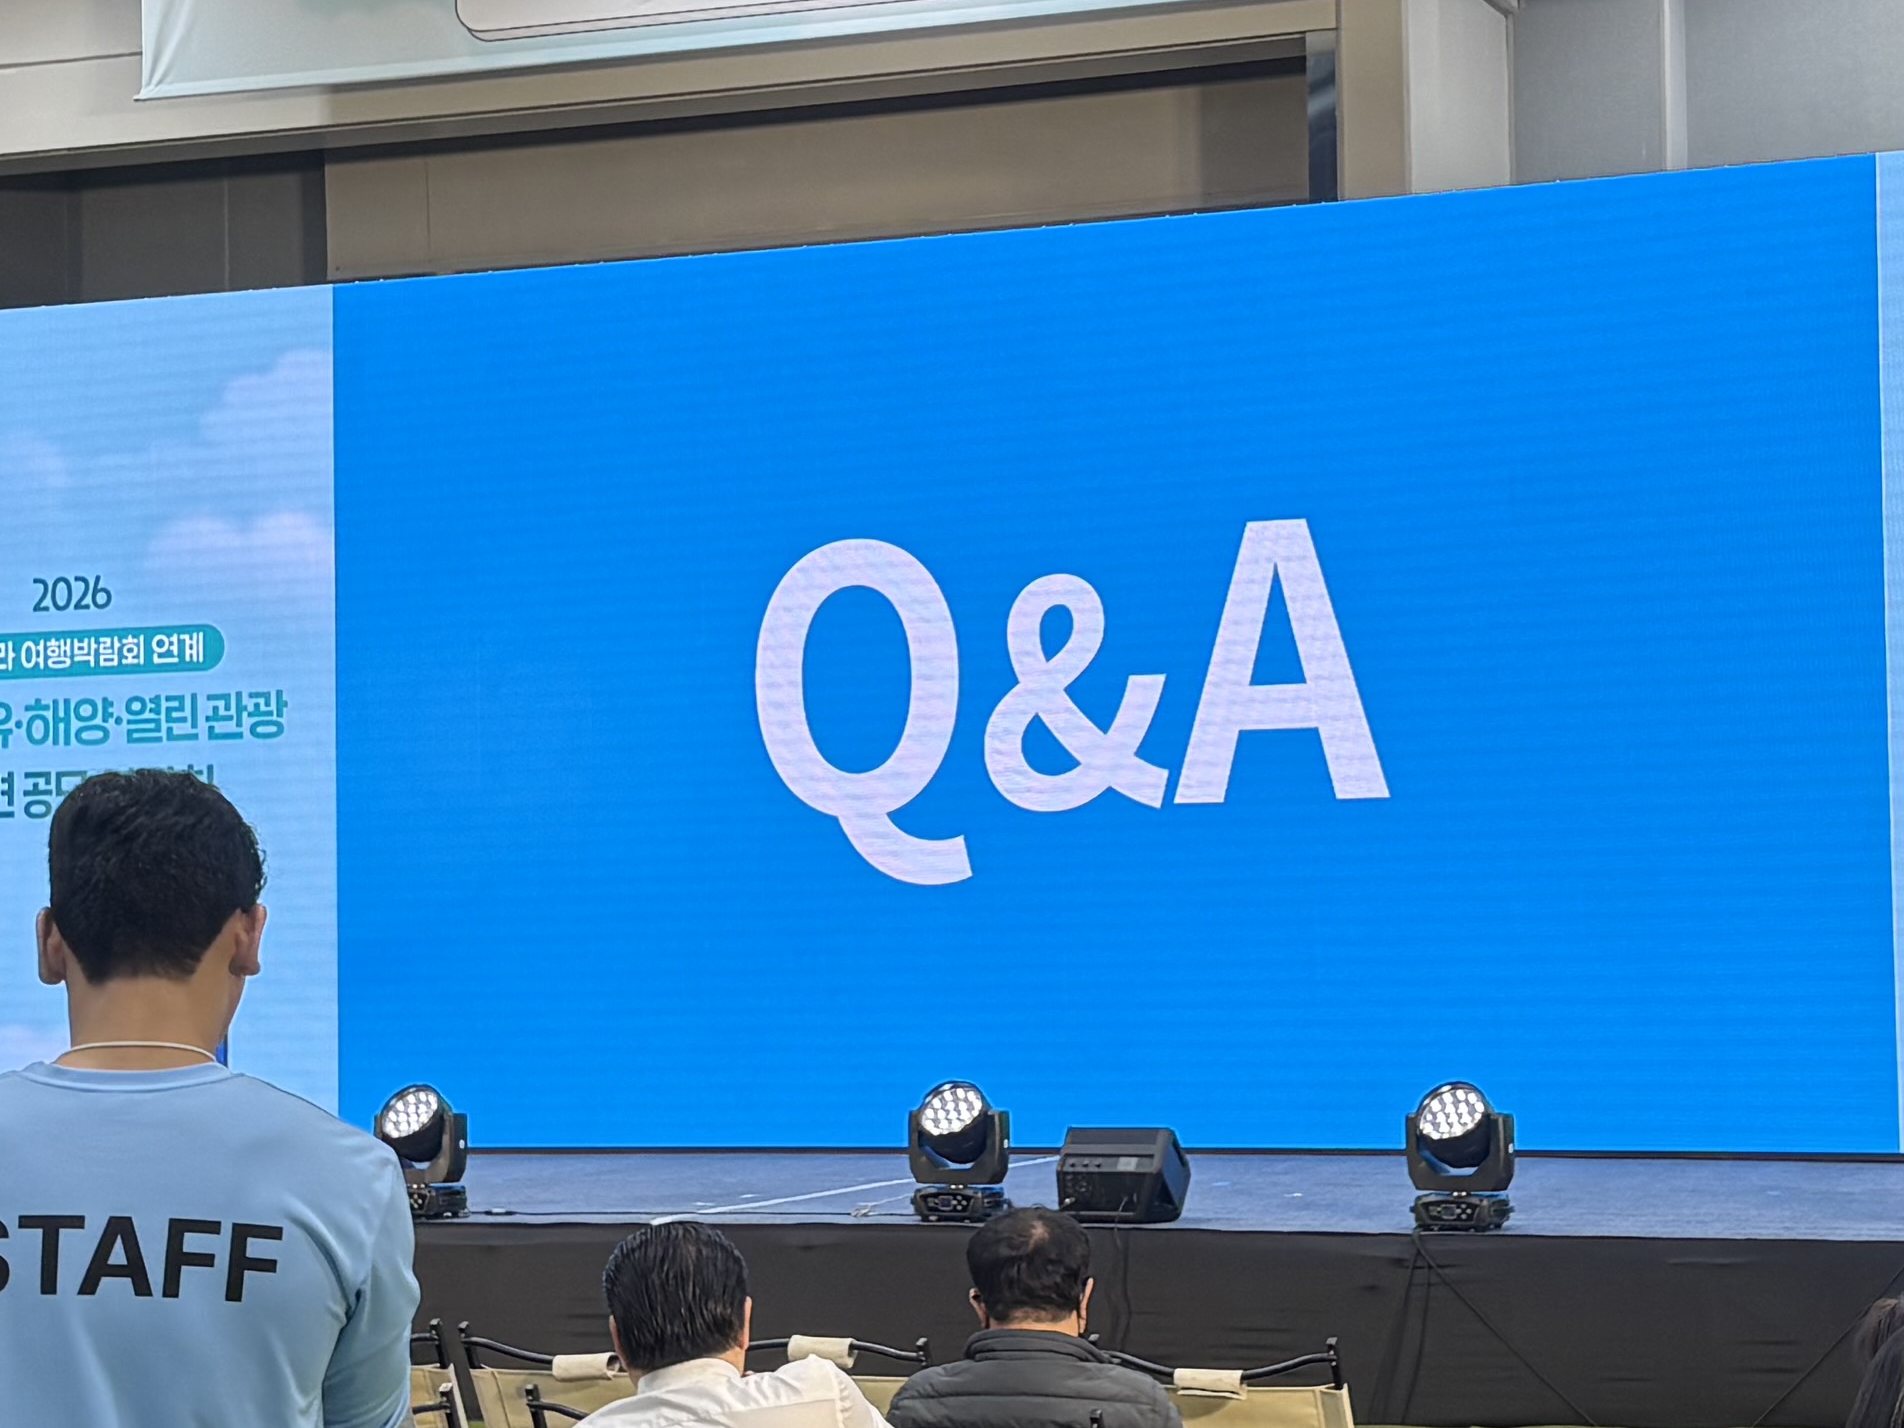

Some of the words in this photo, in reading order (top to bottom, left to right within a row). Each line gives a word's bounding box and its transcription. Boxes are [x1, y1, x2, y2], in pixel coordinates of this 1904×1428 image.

[32, 576, 112, 613] 2026
[22, 636, 145, 669] 여행박람회
[152, 632, 204, 664] 연계
[205, 689, 288, 742] 관광
[754, 517, 1391, 886] Q&A
